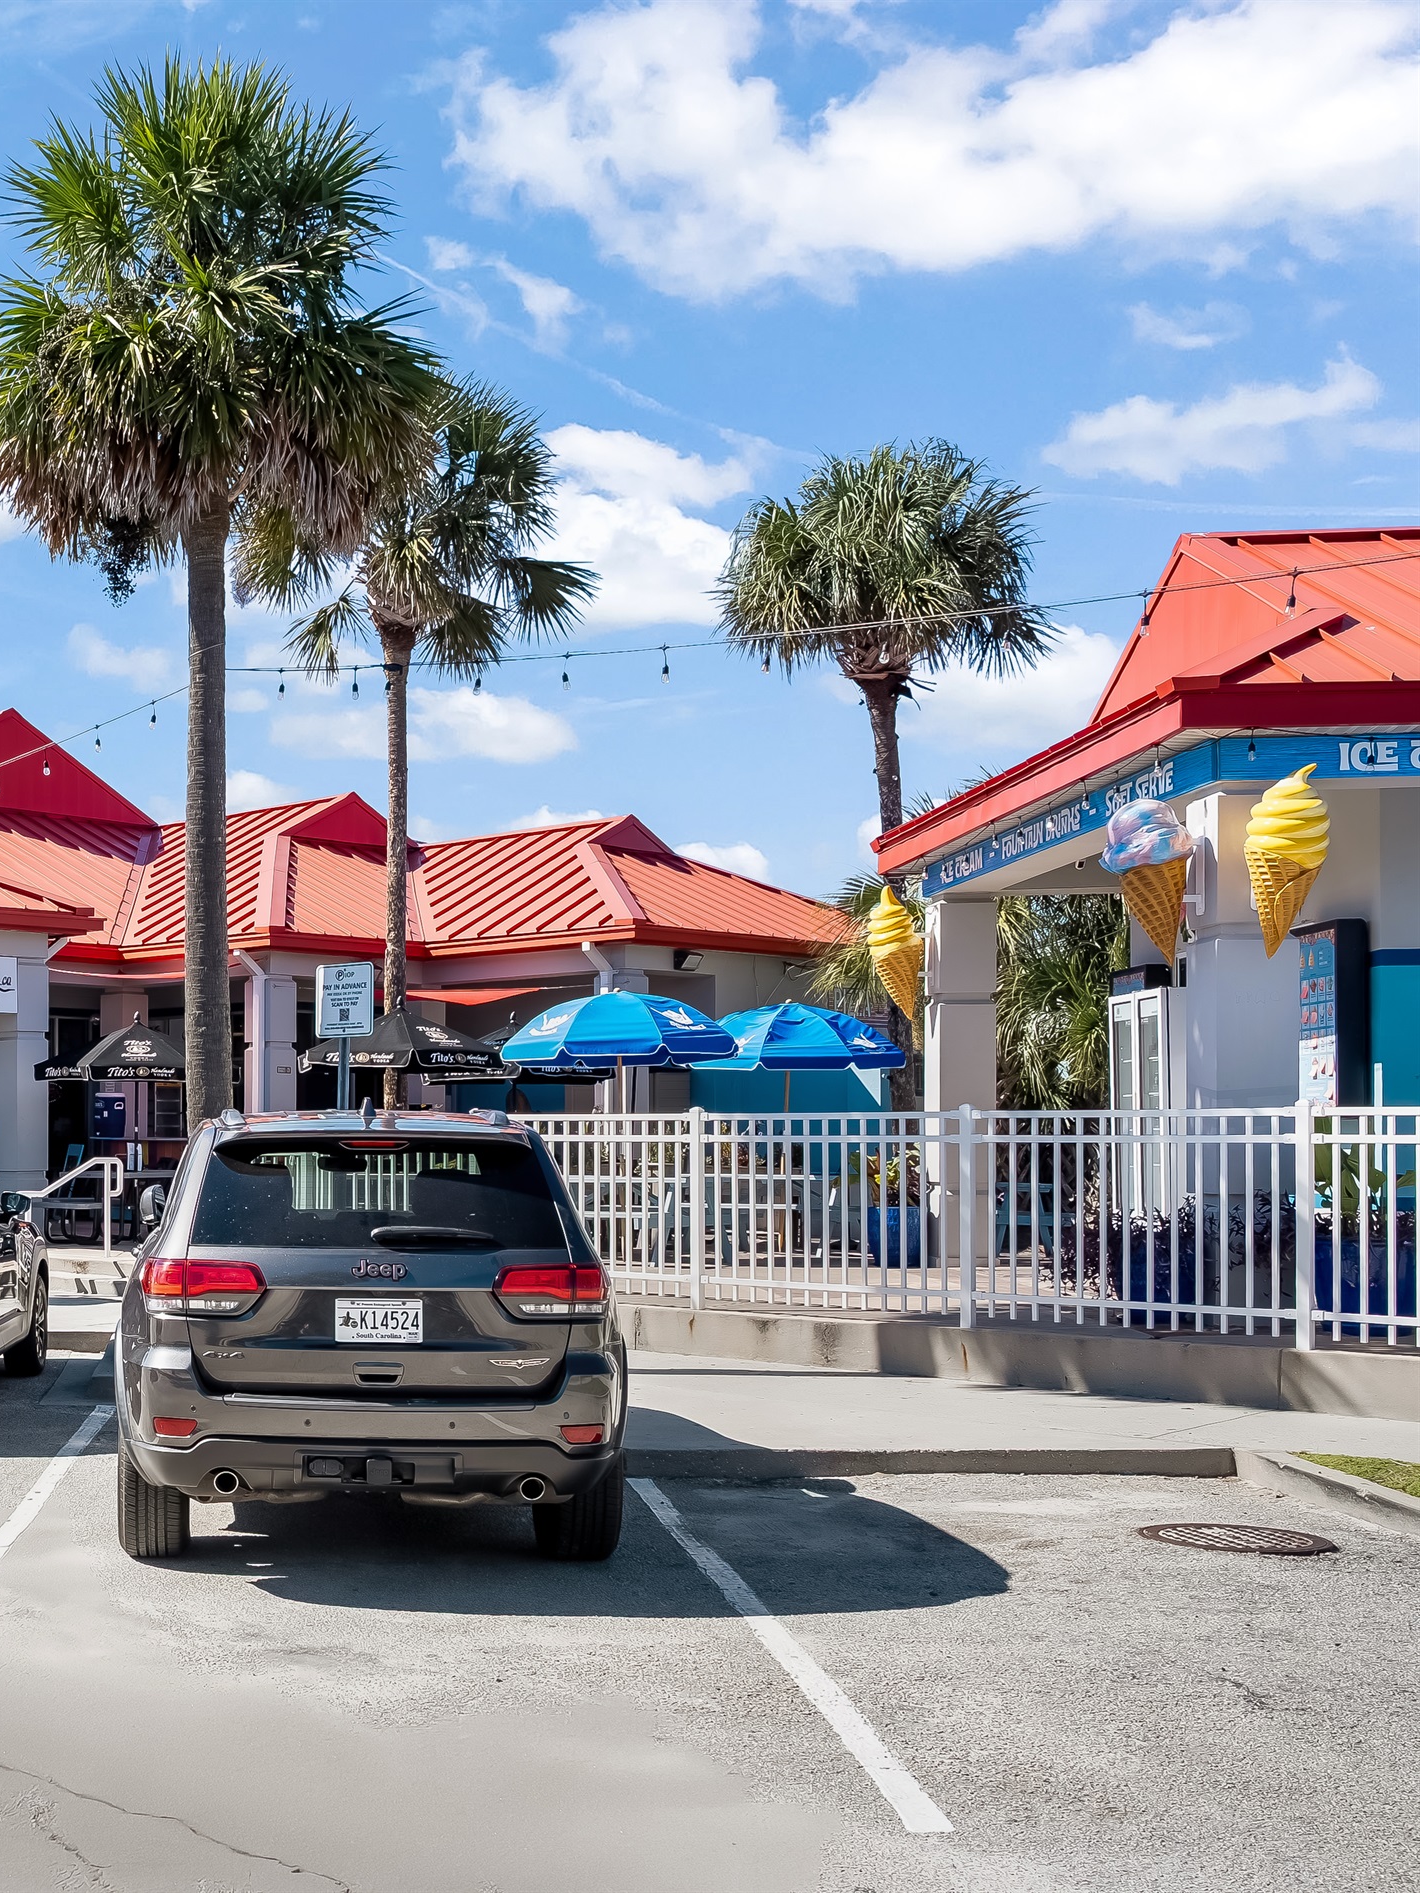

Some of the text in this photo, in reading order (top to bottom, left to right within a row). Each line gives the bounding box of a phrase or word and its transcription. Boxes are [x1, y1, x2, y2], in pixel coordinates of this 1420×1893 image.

[1338, 741, 1399, 772] ICE
[1001, 820, 1044, 860] FOUNTAIN
[1045, 803, 1081, 842] DRINKS
[1135, 761, 1174, 800] SERVE
[323, 981, 368, 992] PAY IN ADVANCE
[430, 1053, 456, 1063] Tito's
[45, 1067, 62, 1077] Tito's
[107, 1066, 136, 1077] Tito's
[351, 1259, 408, 1281] Jeep
[360, 1310, 420, 1331] K14524
